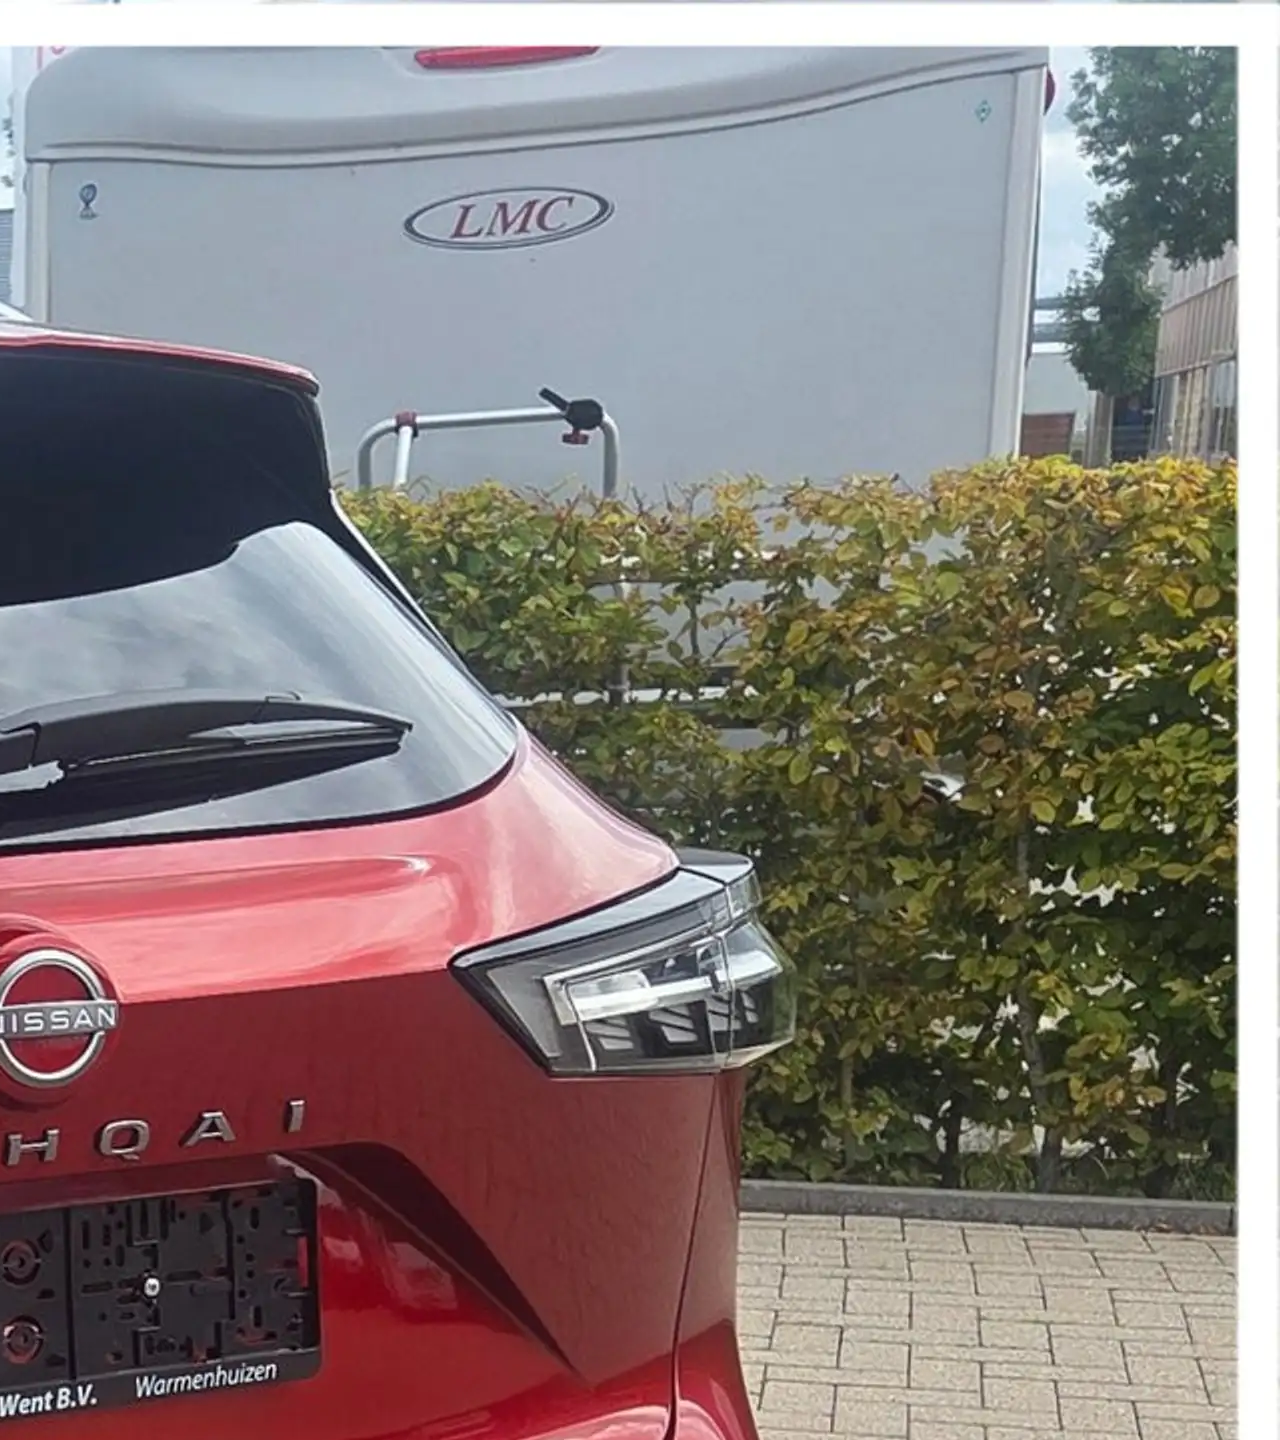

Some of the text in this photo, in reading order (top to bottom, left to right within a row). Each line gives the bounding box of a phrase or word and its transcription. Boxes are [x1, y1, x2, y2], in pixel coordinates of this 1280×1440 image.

[449, 196, 576, 239] LMC
[56, 1383, 98, 1410] B.V.
[134, 1361, 278, 1399] Warmenhuizen
